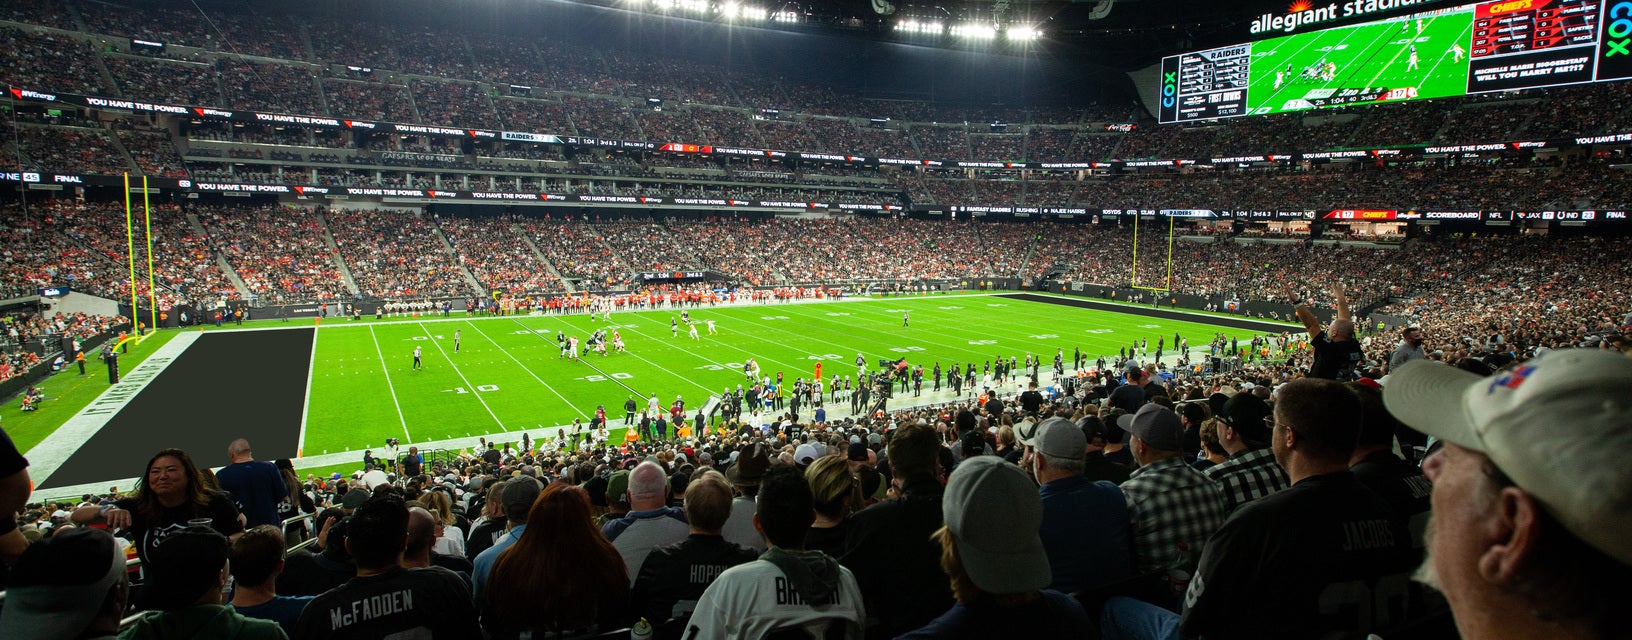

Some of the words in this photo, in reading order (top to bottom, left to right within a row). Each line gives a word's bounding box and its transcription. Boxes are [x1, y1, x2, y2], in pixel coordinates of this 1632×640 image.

[1490, 0, 1533, 13] CHIEFS
[1250, 4, 1336, 34] allegiant
[1606, 2, 1632, 57] COX
[1211, 48, 1246, 59] RAIDERS
[1474, 66, 1508, 75] MICHELLE
[1536, 57, 1588, 68] BIGGERSTAFF
[1520, 68, 1552, 77] MARRY
[1555, 64, 1585, 73] ME?!?
[22, 91, 56, 100] NVEnergy
[1164, 72, 1176, 108] COX
[87, 98, 107, 106] YOU
[109, 100, 133, 109] HAVE
[135, 102, 152, 110] THE
[154, 104, 188, 114] POWER.
[311, 118, 339, 126] POWER.
[1595, 134, 1614, 143] HAVE
[454, 384, 499, 394] 10
[1342, 520, 1395, 551] JACOBS
[330, 589, 414, 630] McFADDEN
